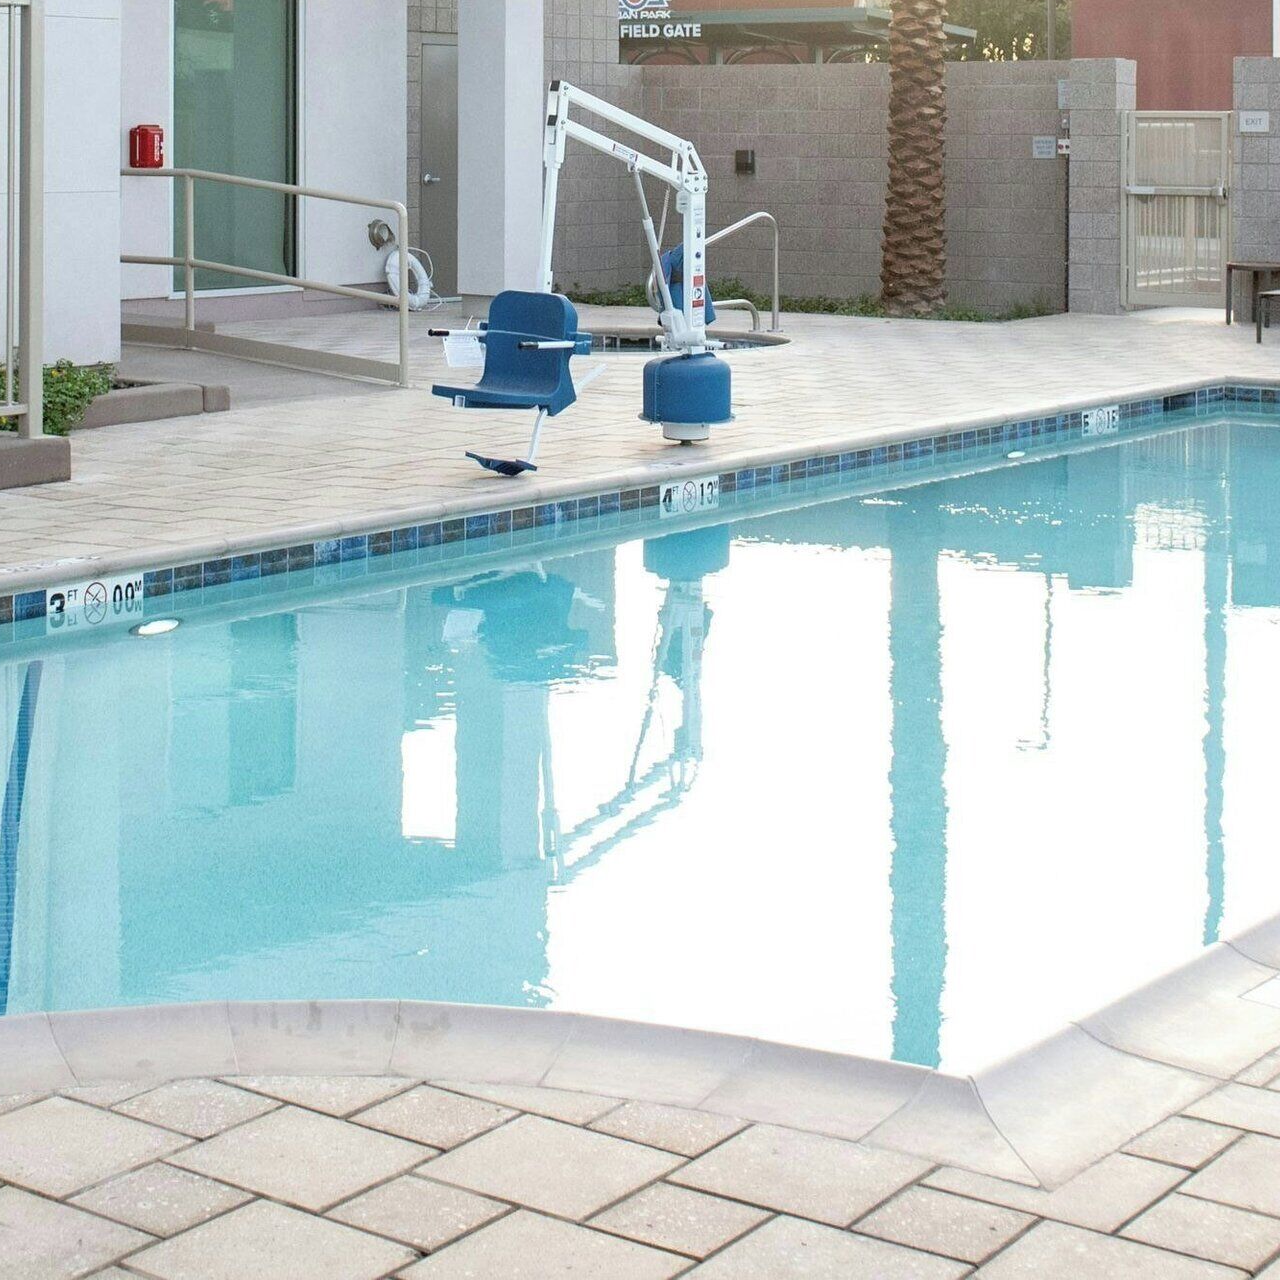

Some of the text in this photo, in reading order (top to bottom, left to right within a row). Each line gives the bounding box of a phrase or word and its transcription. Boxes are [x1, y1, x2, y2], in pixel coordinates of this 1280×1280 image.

[640, 10, 672, 20] PARK
[620, 23, 702, 39] FIELD GATE
[1245, 117, 1263, 126] EXIT
